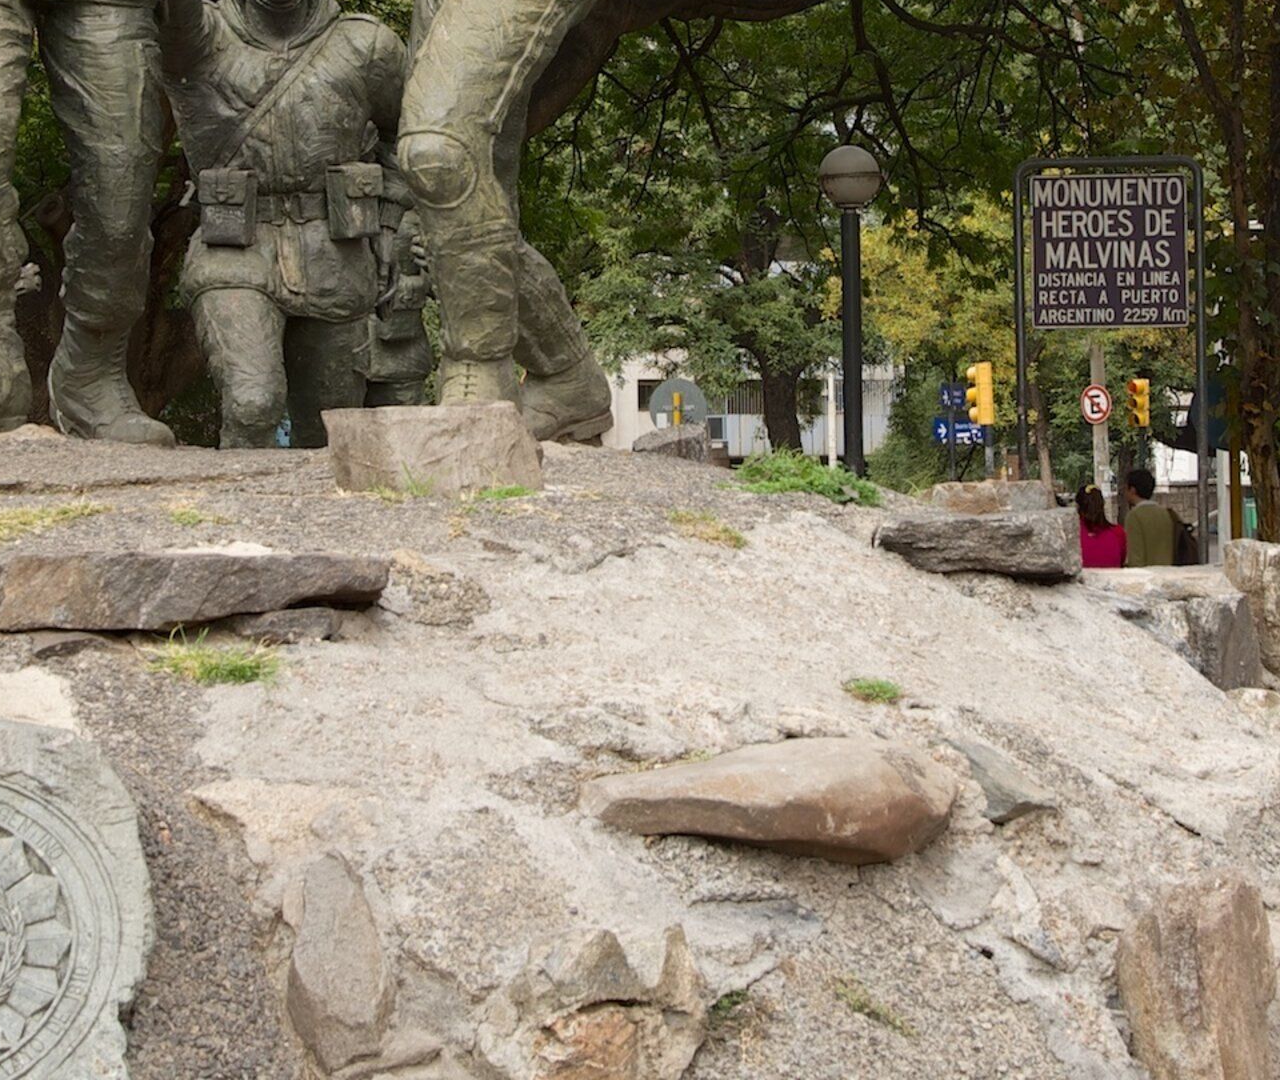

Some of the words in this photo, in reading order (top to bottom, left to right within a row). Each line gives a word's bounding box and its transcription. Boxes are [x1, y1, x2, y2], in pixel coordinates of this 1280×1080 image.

[1033, 178, 1183, 207] MONUMENTO
[1041, 210, 1133, 238] HEROES
[1145, 209, 1176, 237] DE
[1046, 240, 1171, 269] MALVINAS
[1038, 272, 1107, 287] DISTANCIA
[1117, 272, 1135, 286] EN
[1143, 271, 1180, 286] LINEA
[1039, 290, 1087, 305] RECTA
[1099, 290, 1108, 304] A
[1121, 289, 1179, 304] PUERTO
[1039, 308, 1115, 323] ARGENTINO
[1123, 307, 1158, 322] 2259
[1163, 307, 1186, 322] Km
